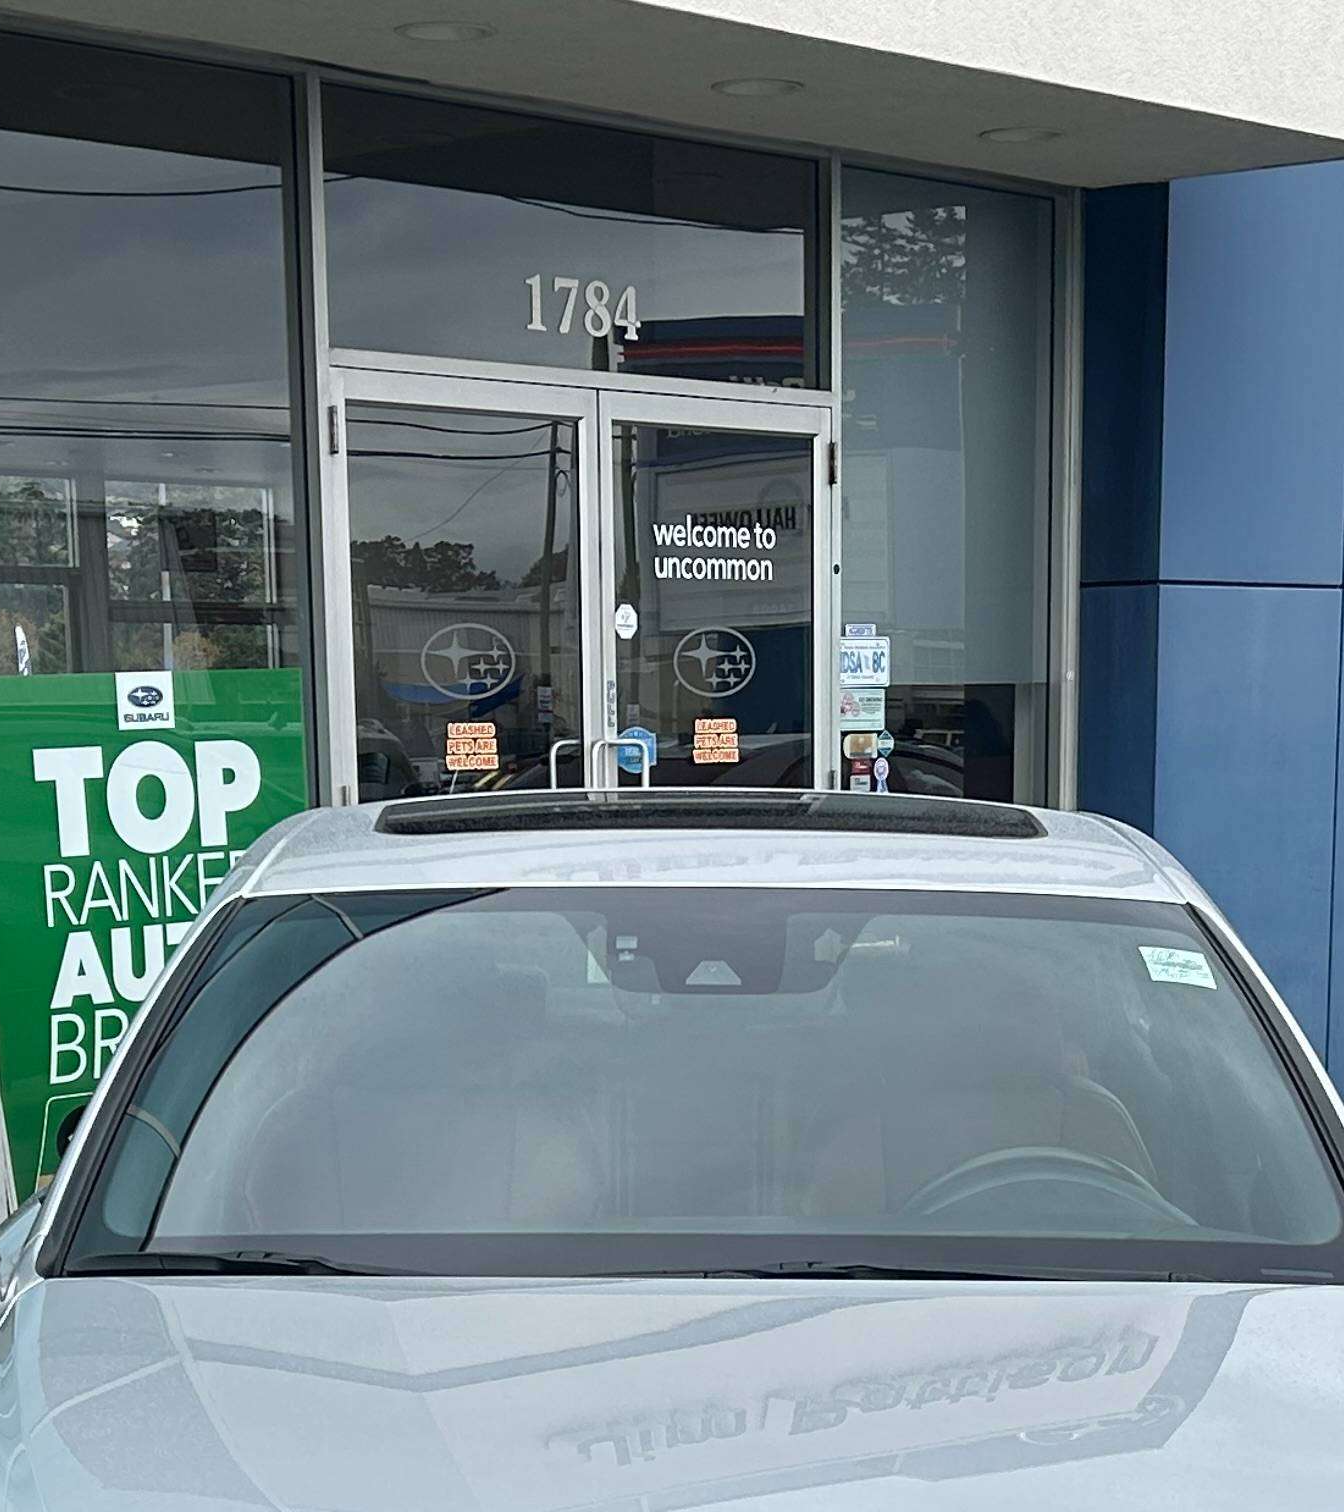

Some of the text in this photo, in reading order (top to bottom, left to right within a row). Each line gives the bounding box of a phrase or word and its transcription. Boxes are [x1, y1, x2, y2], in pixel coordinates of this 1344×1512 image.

[525, 273, 641, 340] 1784
[653, 514, 776, 549] welcome to
[654, 557, 773, 581] uncommon
[123, 711, 169, 723] SUBARU
[448, 741, 474, 752] PETS
[448, 756, 497, 768] WELCOME
[32, 739, 262, 857] TOP
[44, 850, 248, 927] RANKE
[50, 1008, 129, 1085] BR
